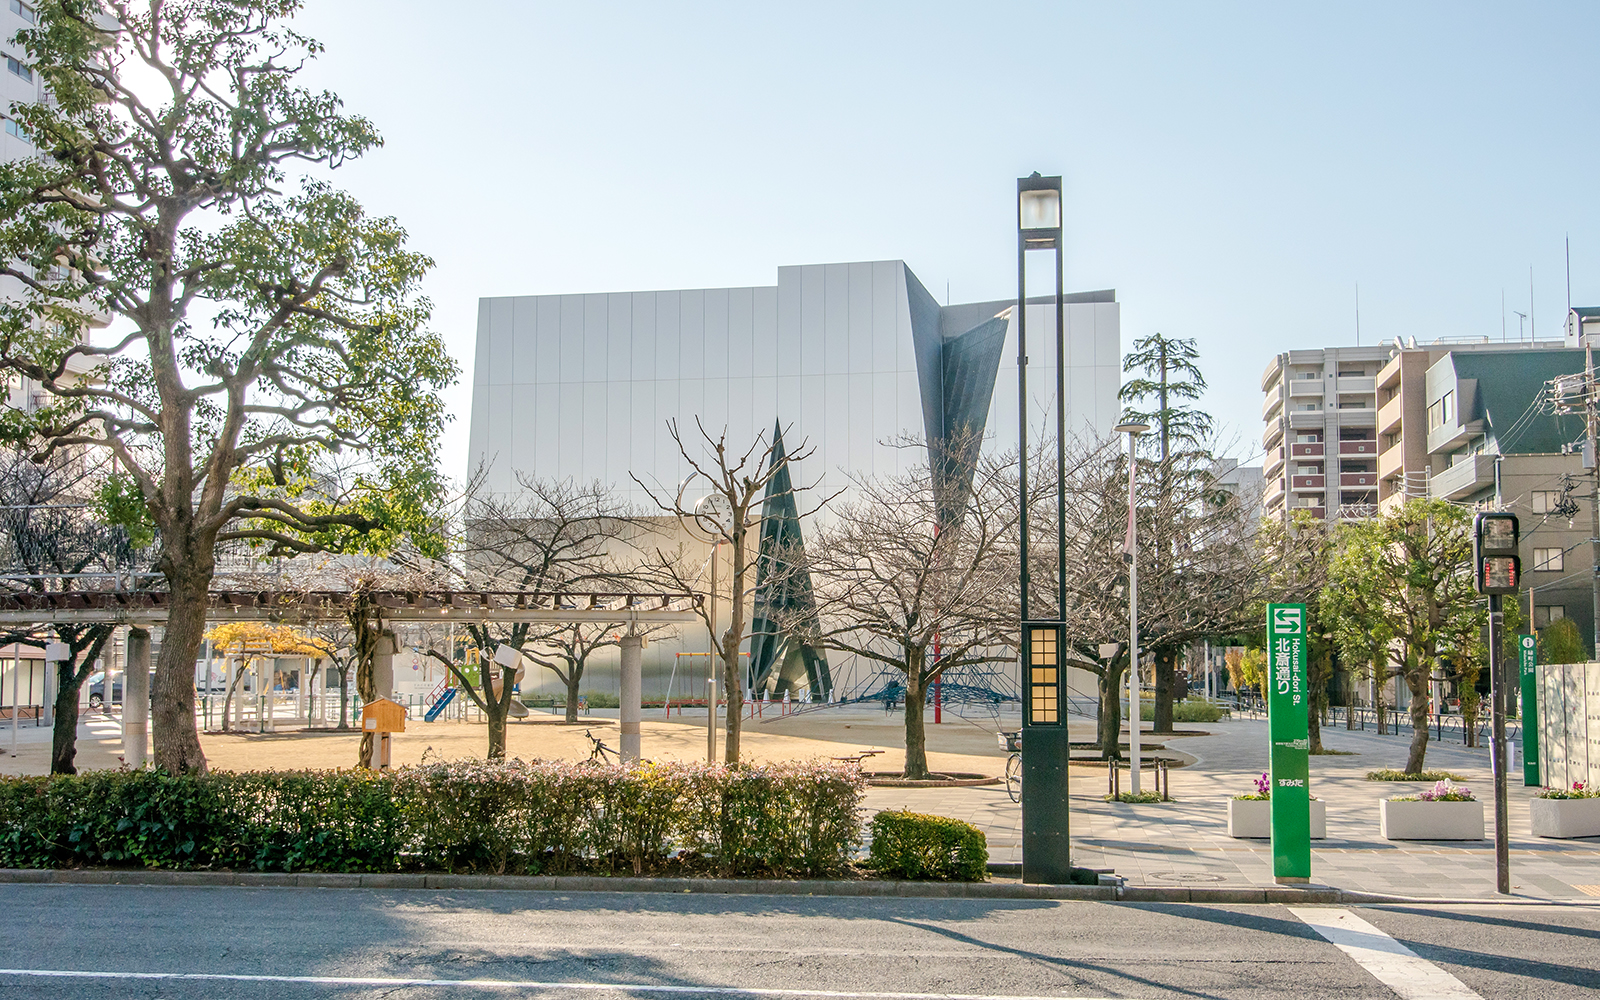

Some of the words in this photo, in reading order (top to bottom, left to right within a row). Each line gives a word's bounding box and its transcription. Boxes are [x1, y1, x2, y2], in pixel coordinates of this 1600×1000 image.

[1275, 638, 1290, 694] 北斎通り
[1292, 638, 1301, 693] Hokusai-dori
[1292, 694, 1301, 706] St.
[1278, 779, 1304, 787] すみだ
